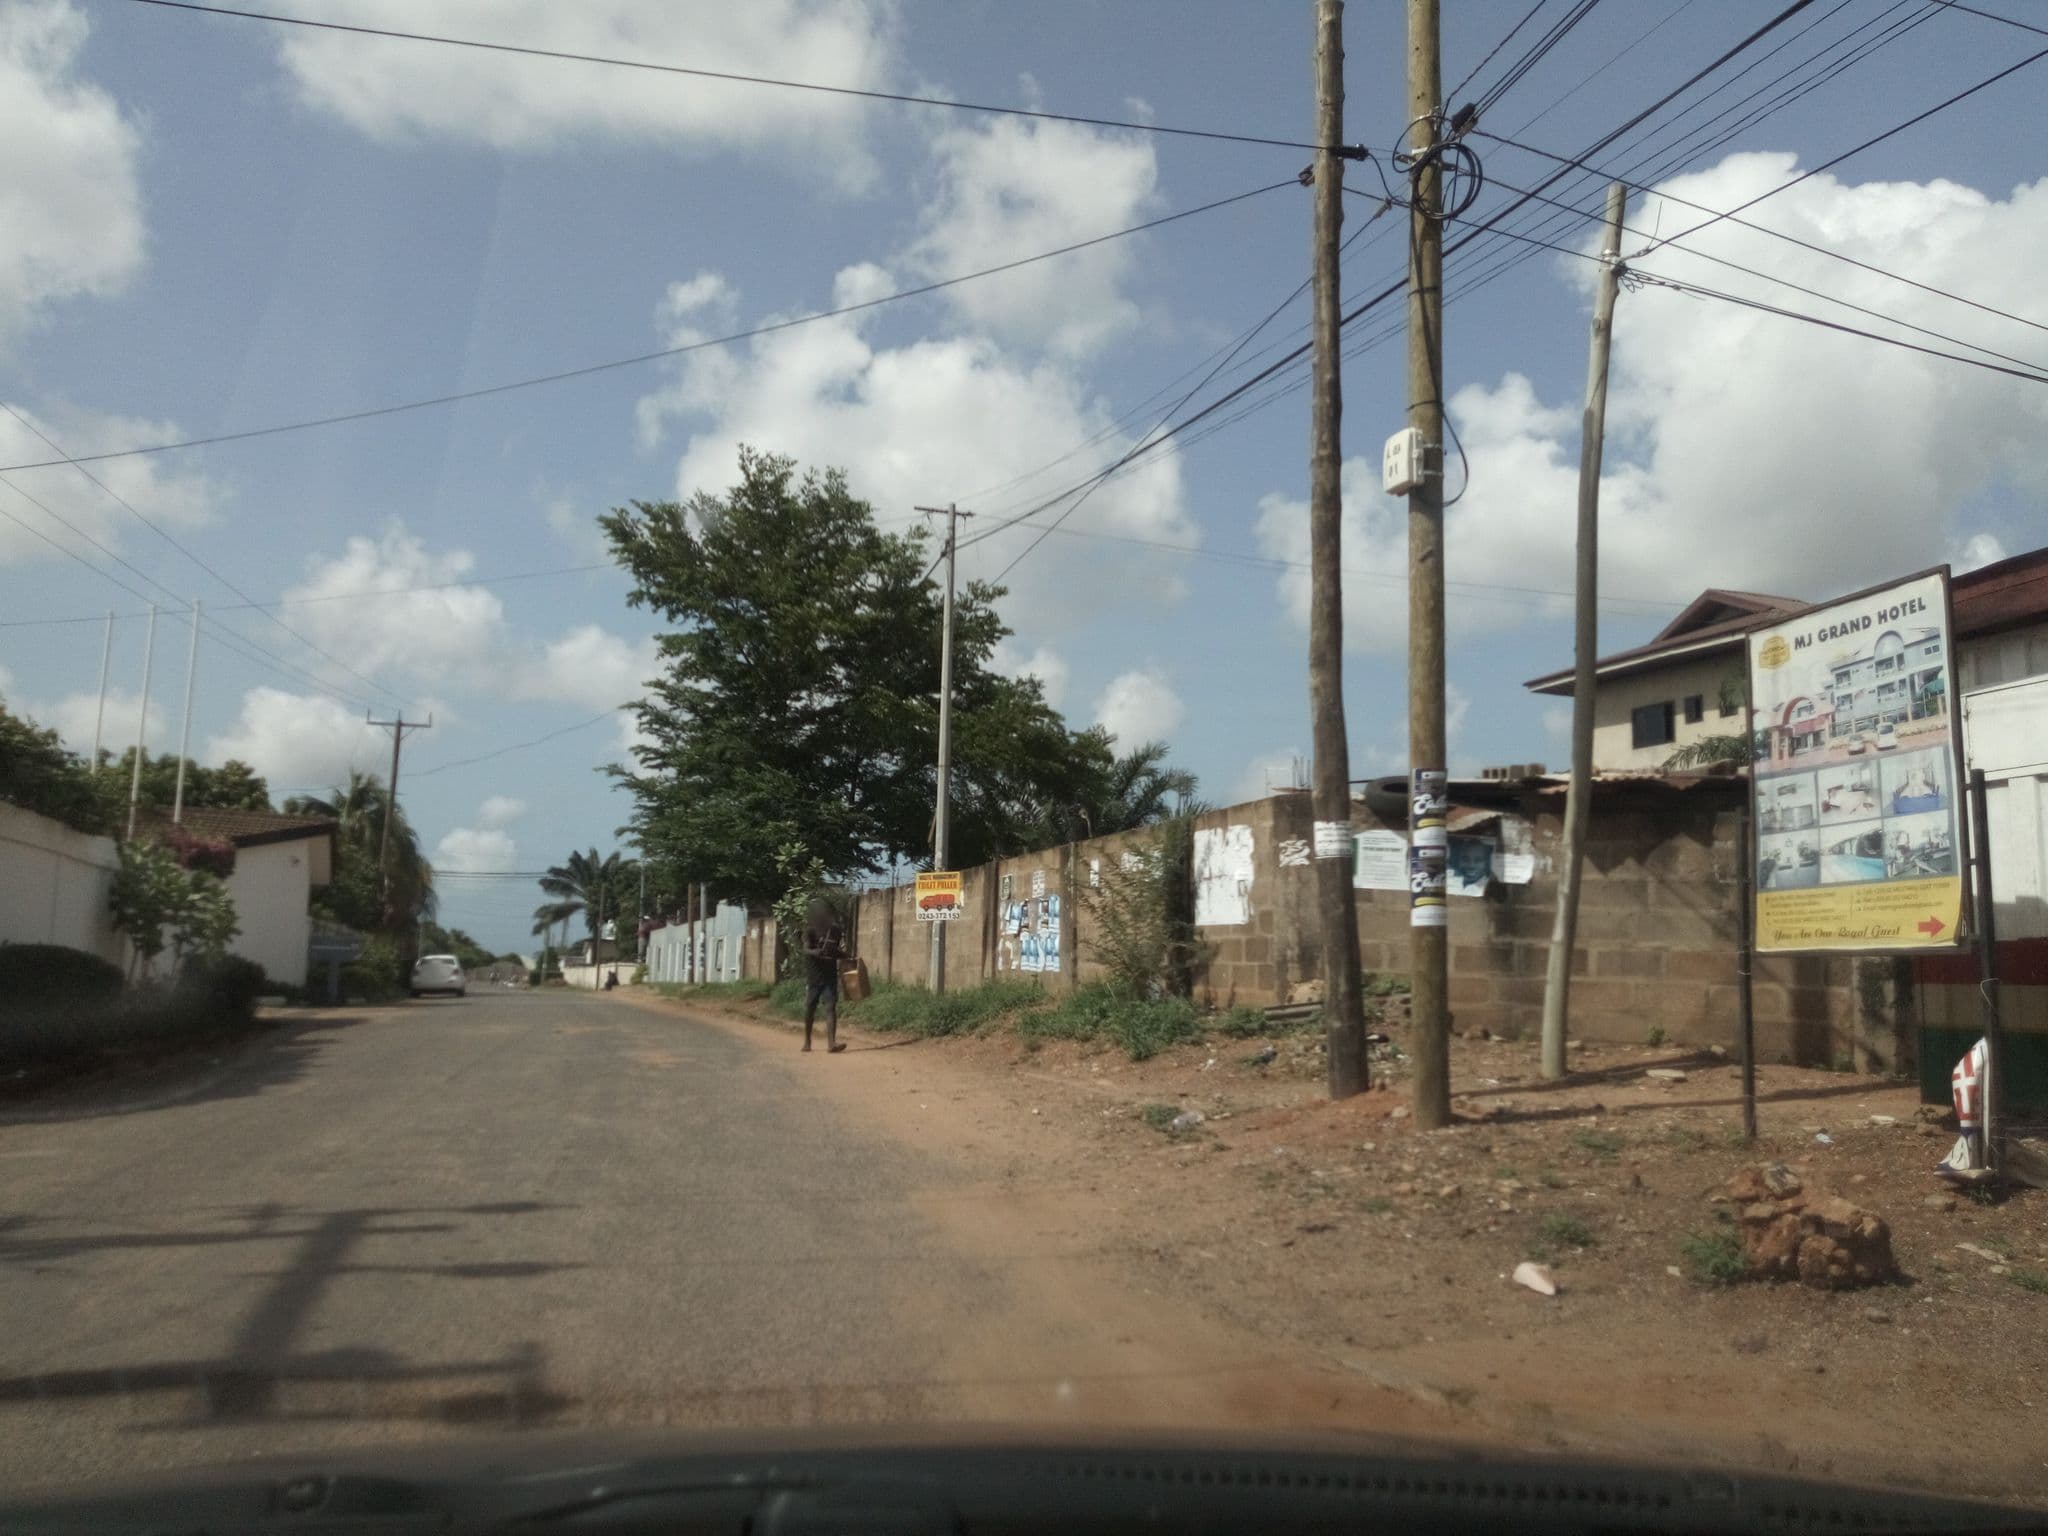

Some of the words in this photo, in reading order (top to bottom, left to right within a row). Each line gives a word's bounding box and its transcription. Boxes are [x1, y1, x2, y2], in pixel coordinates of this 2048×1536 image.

[1794, 633, 1812, 650] MJ
[1817, 615, 1872, 643] GRAND
[1877, 597, 1926, 625] HOTEL
[1838, 926, 1868, 938] Royal
[1871, 925, 1901, 939] Guest
